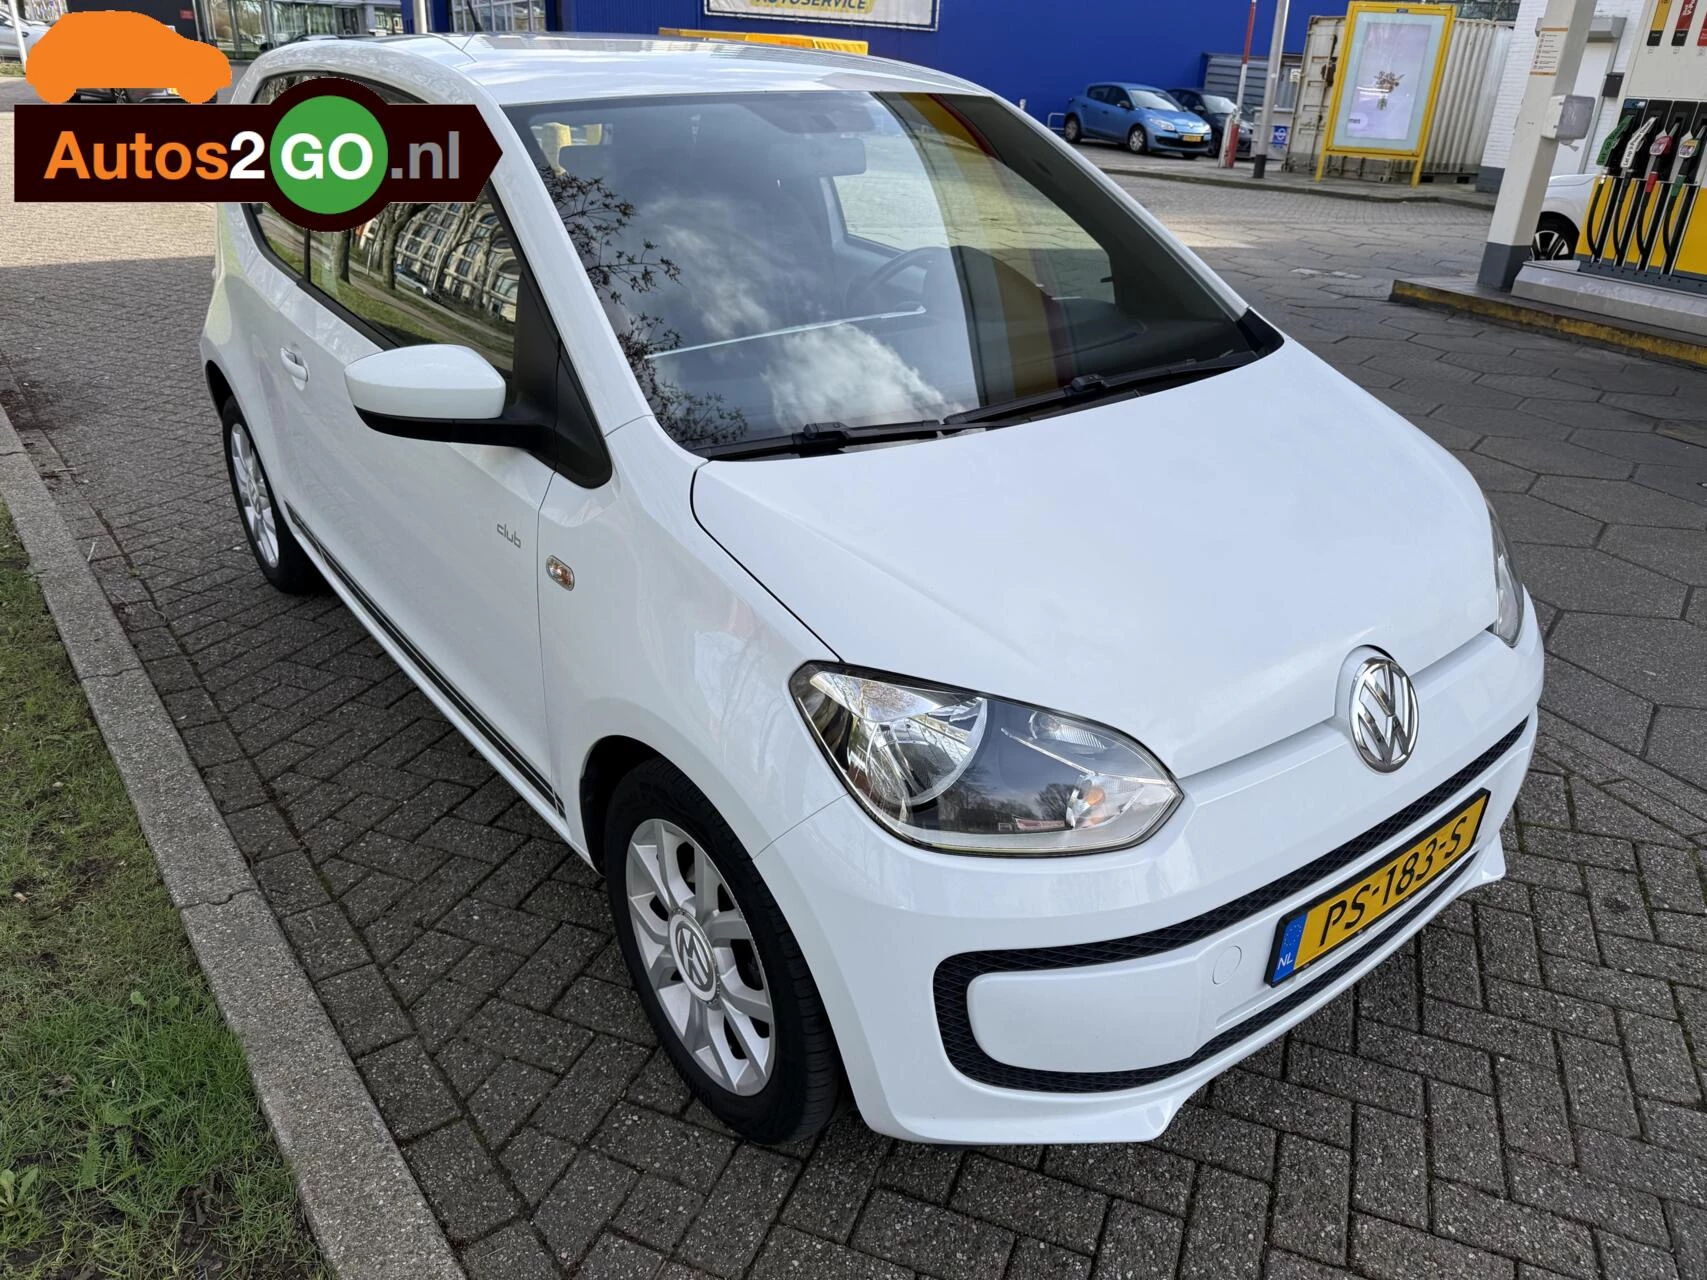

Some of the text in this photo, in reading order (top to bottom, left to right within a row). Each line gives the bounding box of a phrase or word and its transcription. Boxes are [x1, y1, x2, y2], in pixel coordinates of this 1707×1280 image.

[755, 0, 866, 9] SERVICE
[496, 523, 522, 549] club
[1319, 816, 1467, 947] PS-183-S
[1277, 952, 1293, 969] NL
